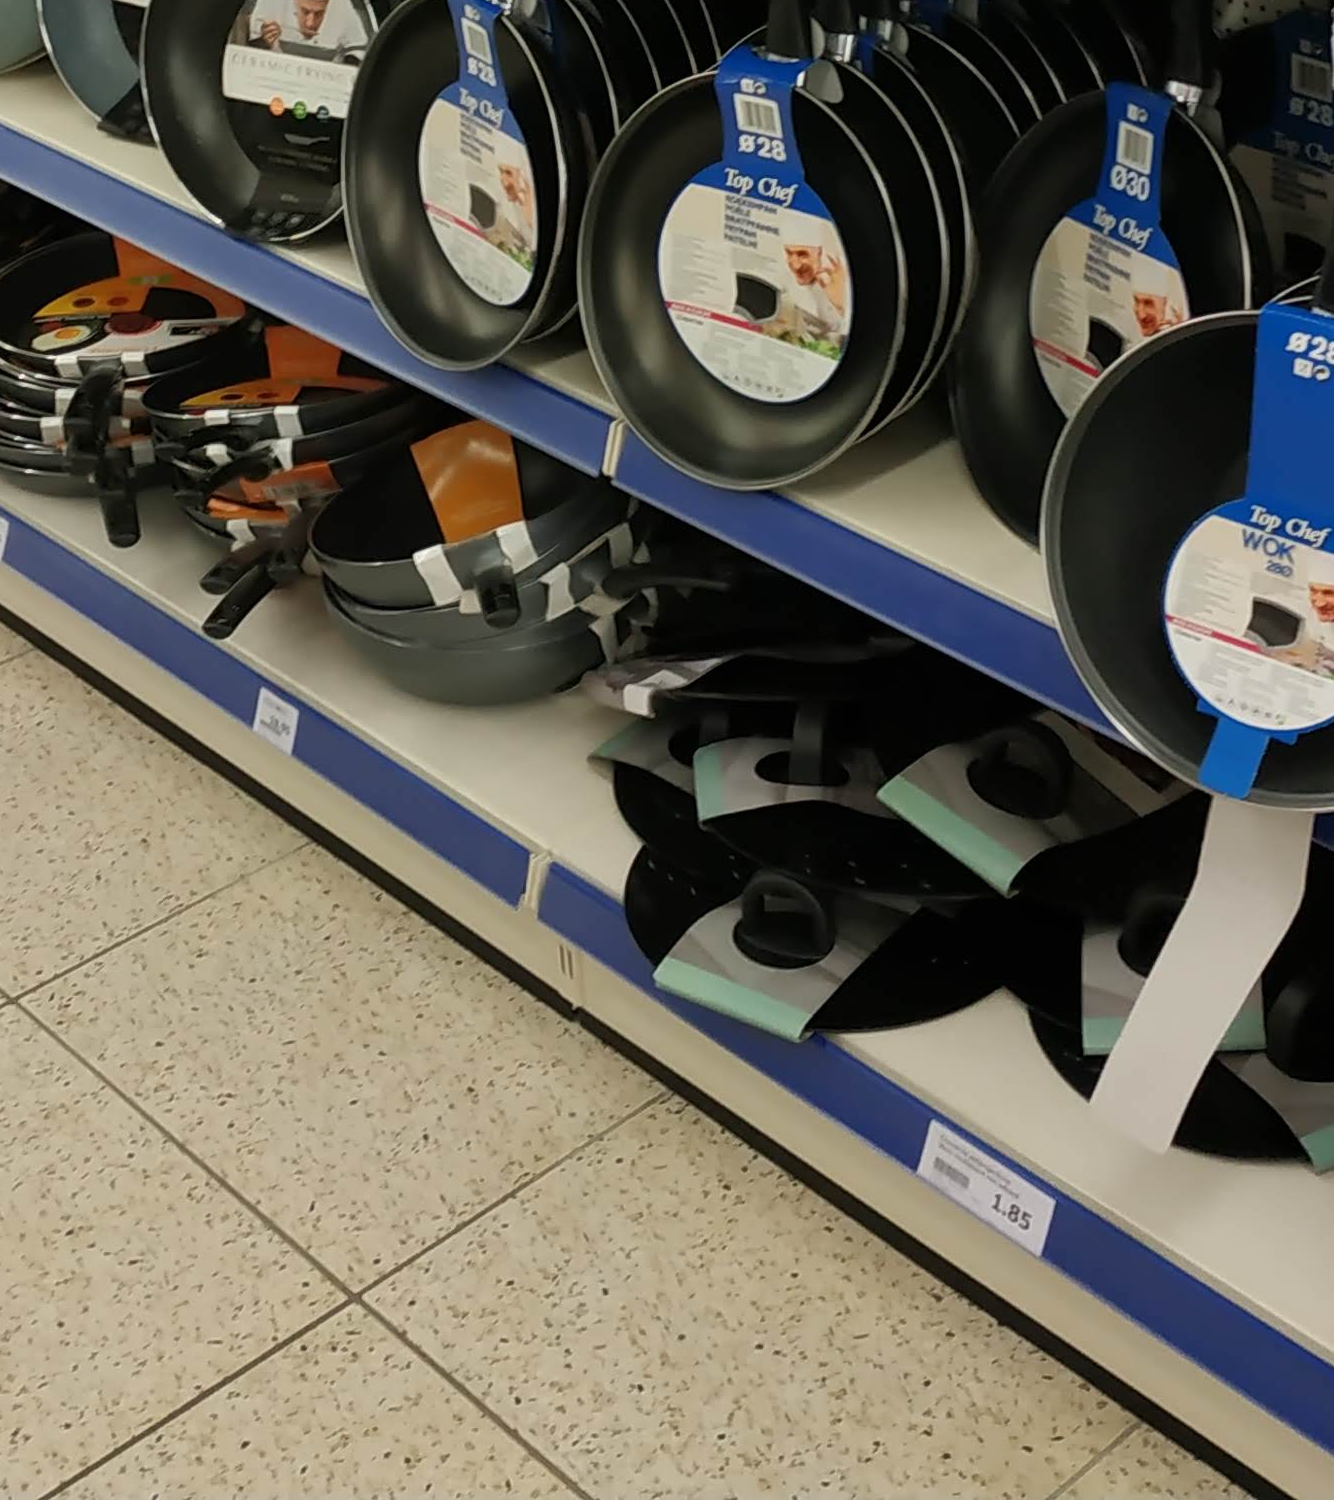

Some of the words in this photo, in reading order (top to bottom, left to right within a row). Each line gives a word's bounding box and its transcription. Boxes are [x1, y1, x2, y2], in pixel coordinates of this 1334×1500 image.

[231, 52, 292, 76] CERAMIC
[459, 87, 479, 112] Top
[479, 97, 505, 129] Chef
[738, 134, 787, 163] Ø28
[723, 167, 754, 198] Top
[755, 176, 799, 209] Chef
[1109, 169, 1151, 202] Ø30
[1092, 204, 1118, 231] Top
[1119, 214, 1154, 250] Chef
[1241, 526, 1296, 564] WOK
[1249, 503, 1284, 536] Top
[1285, 513, 1332, 549] Chef
[990, 1192, 1033, 1233] 1.85
